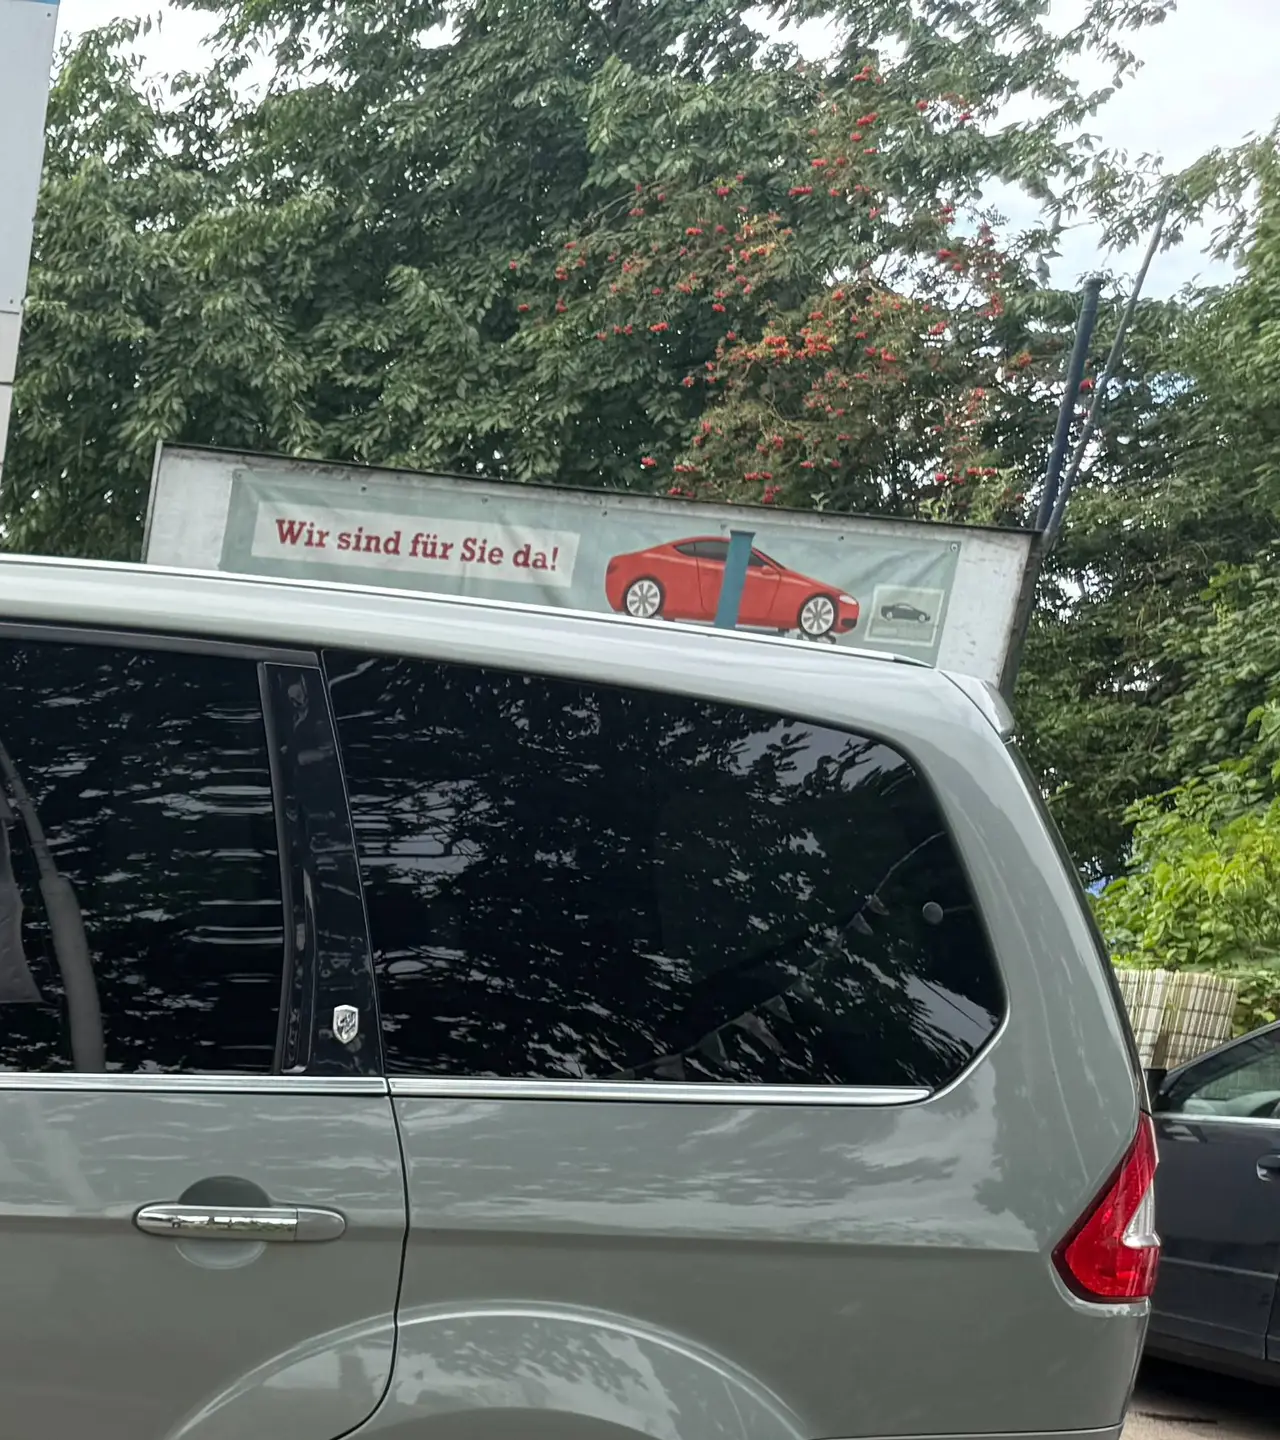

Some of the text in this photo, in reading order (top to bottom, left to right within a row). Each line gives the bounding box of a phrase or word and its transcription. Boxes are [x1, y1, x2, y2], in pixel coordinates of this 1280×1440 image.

[275, 519, 559, 571] Wir sind für Sie da!
